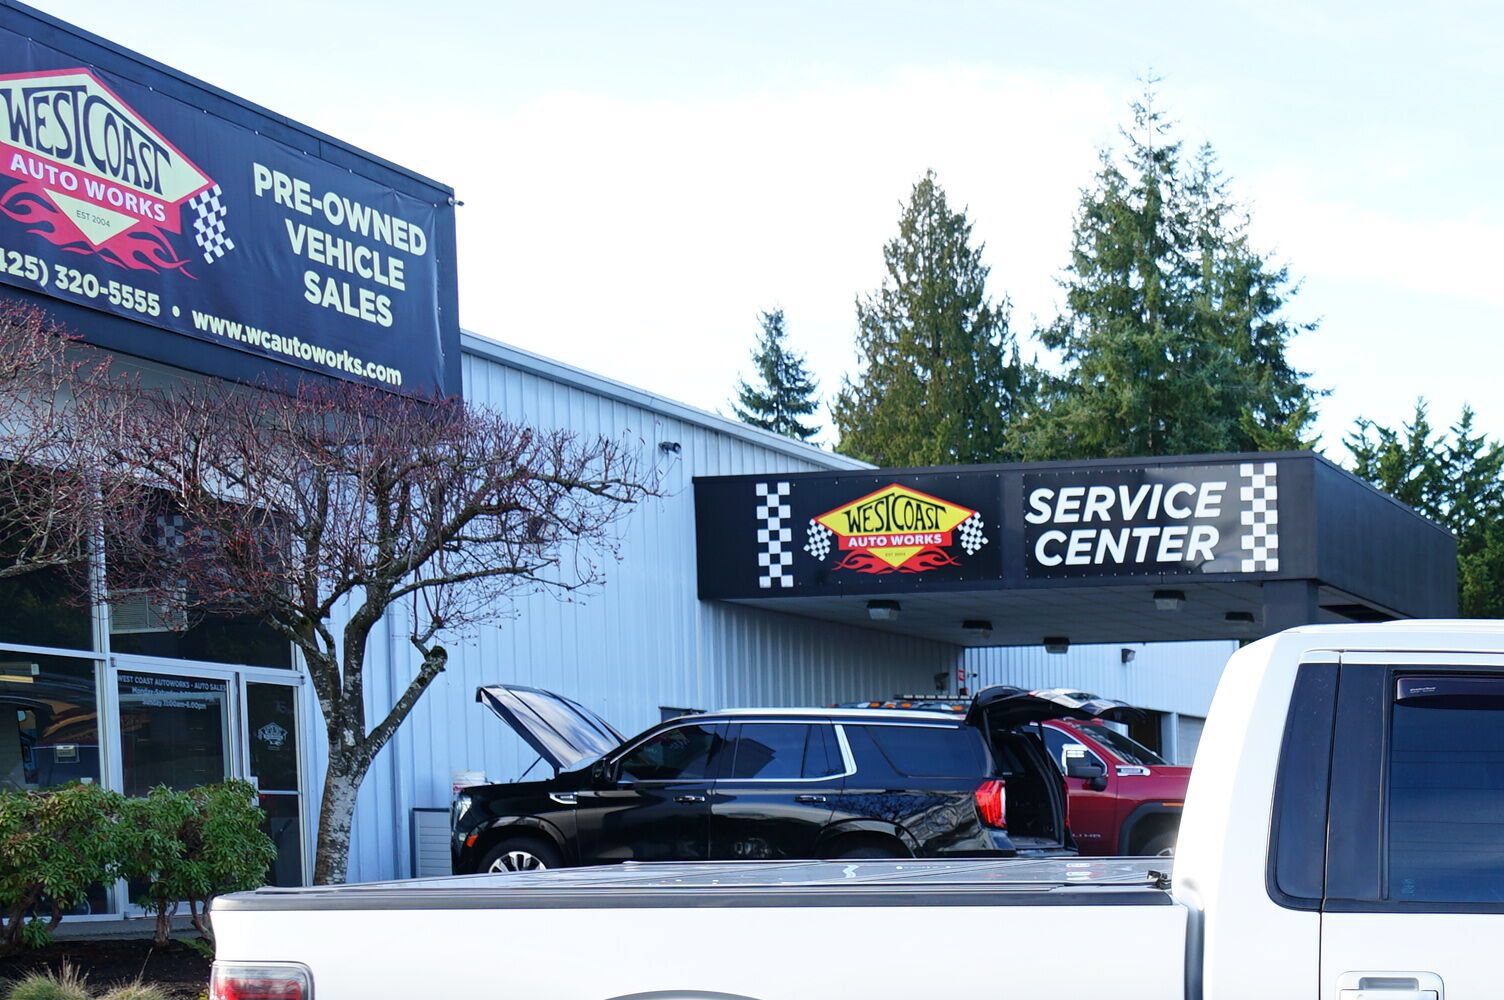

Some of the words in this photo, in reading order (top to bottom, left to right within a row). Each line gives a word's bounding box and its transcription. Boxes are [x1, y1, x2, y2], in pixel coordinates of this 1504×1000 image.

[10, 153, 78, 191] AUTO
[83, 177, 167, 222] WORKS
[253, 162, 427, 257] PRE-OWNED
[76, 209, 91, 223] EST
[91, 213, 111, 228] 2004
[285, 218, 405, 291] VEHICLE
[54, 264, 161, 317] 320-5555
[192, 310, 402, 386] www.wcautoworks.com
[304, 270, 393, 328] SALES
[1025, 481, 1227, 524] SERVICE
[848, 535, 887, 547] AUTO
[891, 534, 942, 545] WORKS
[1035, 525, 1220, 567] CENTER
